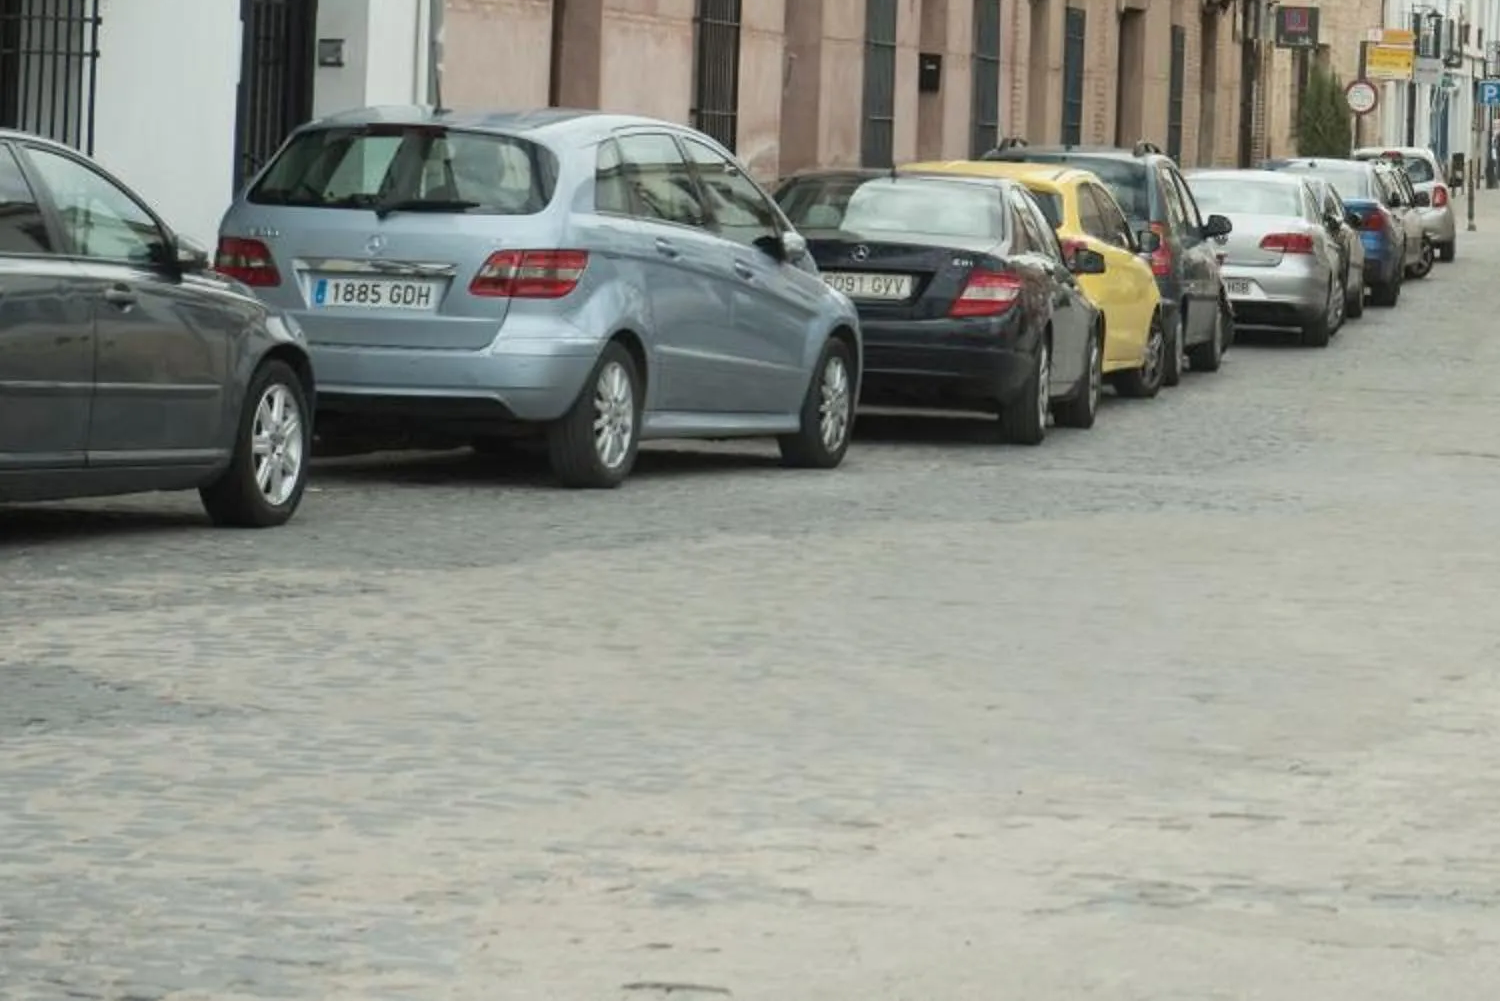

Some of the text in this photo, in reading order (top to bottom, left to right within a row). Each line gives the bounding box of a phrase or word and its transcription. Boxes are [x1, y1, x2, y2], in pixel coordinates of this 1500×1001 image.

[1483, 84, 1497, 102] P
[333, 282, 431, 307] 1885 GDH
